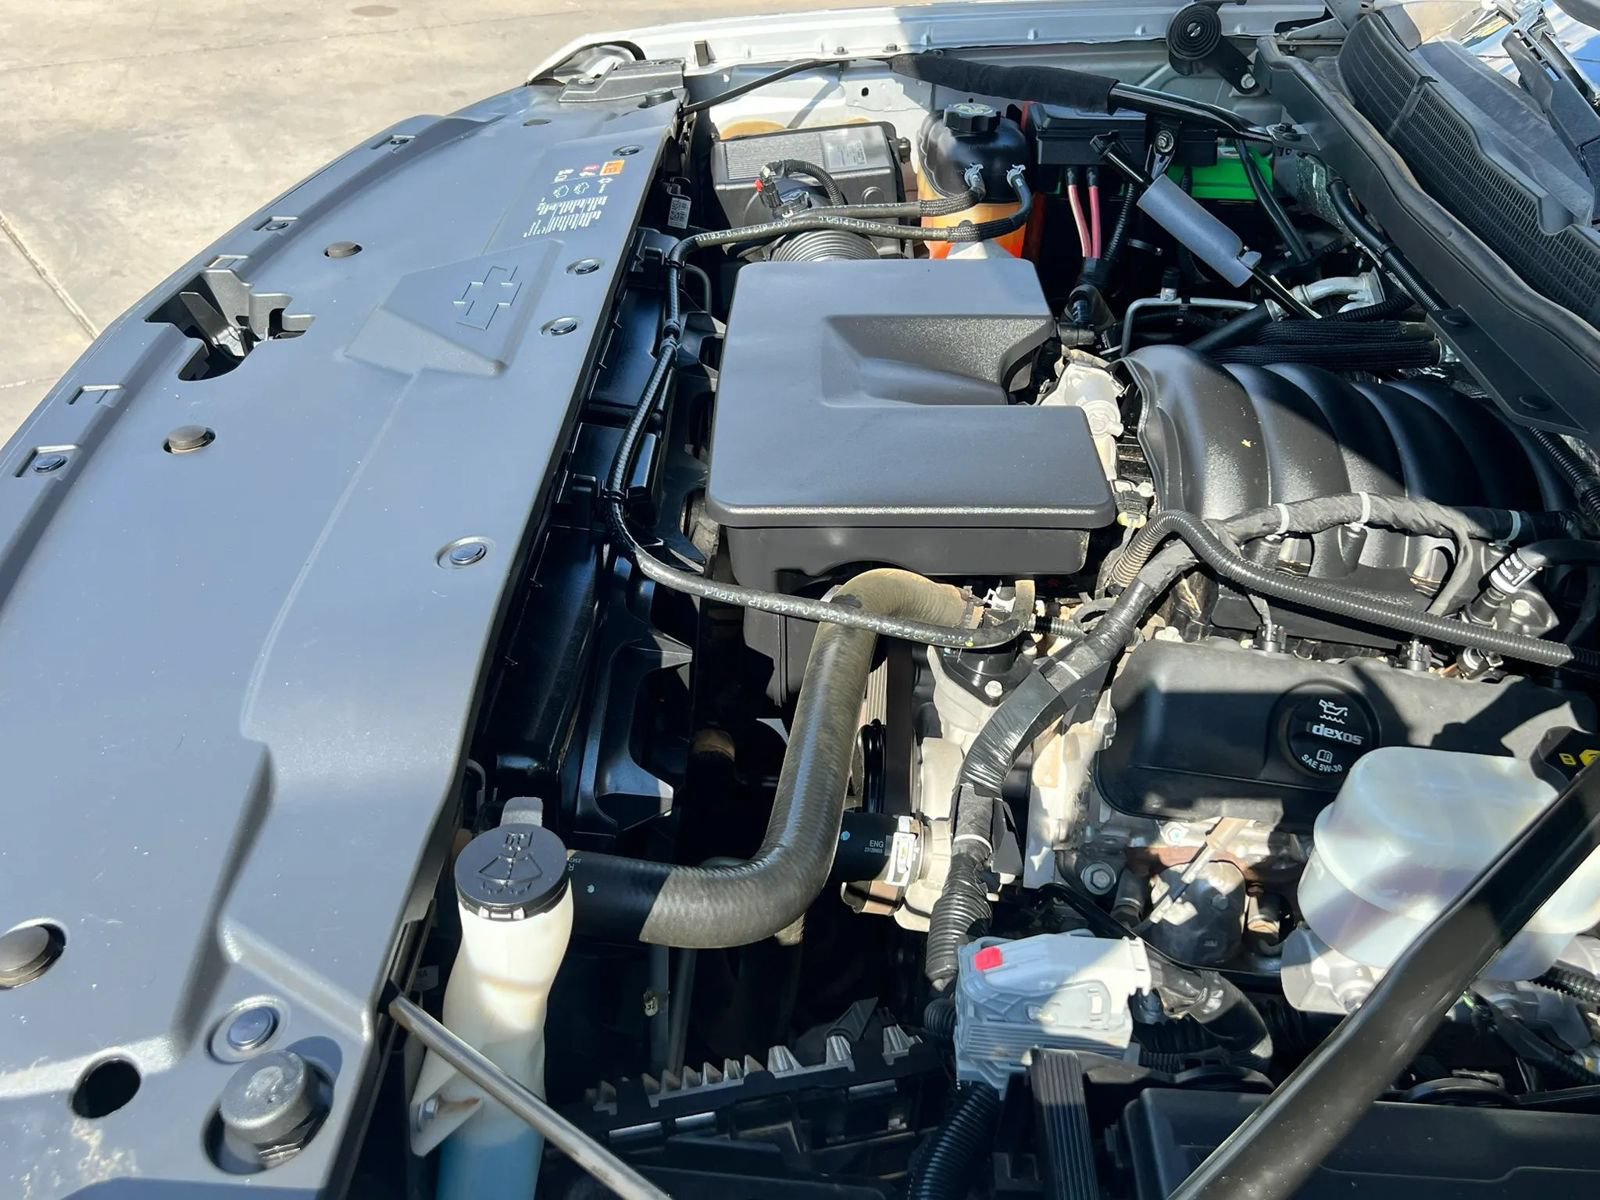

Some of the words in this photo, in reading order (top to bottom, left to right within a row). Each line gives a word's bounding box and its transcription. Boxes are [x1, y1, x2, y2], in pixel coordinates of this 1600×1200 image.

[1312, 723, 1364, 745] dexos
[1301, 754, 1318, 769] SAE
[1319, 763, 1343, 773] 5W-30
[869, 839, 884, 848] ENG
